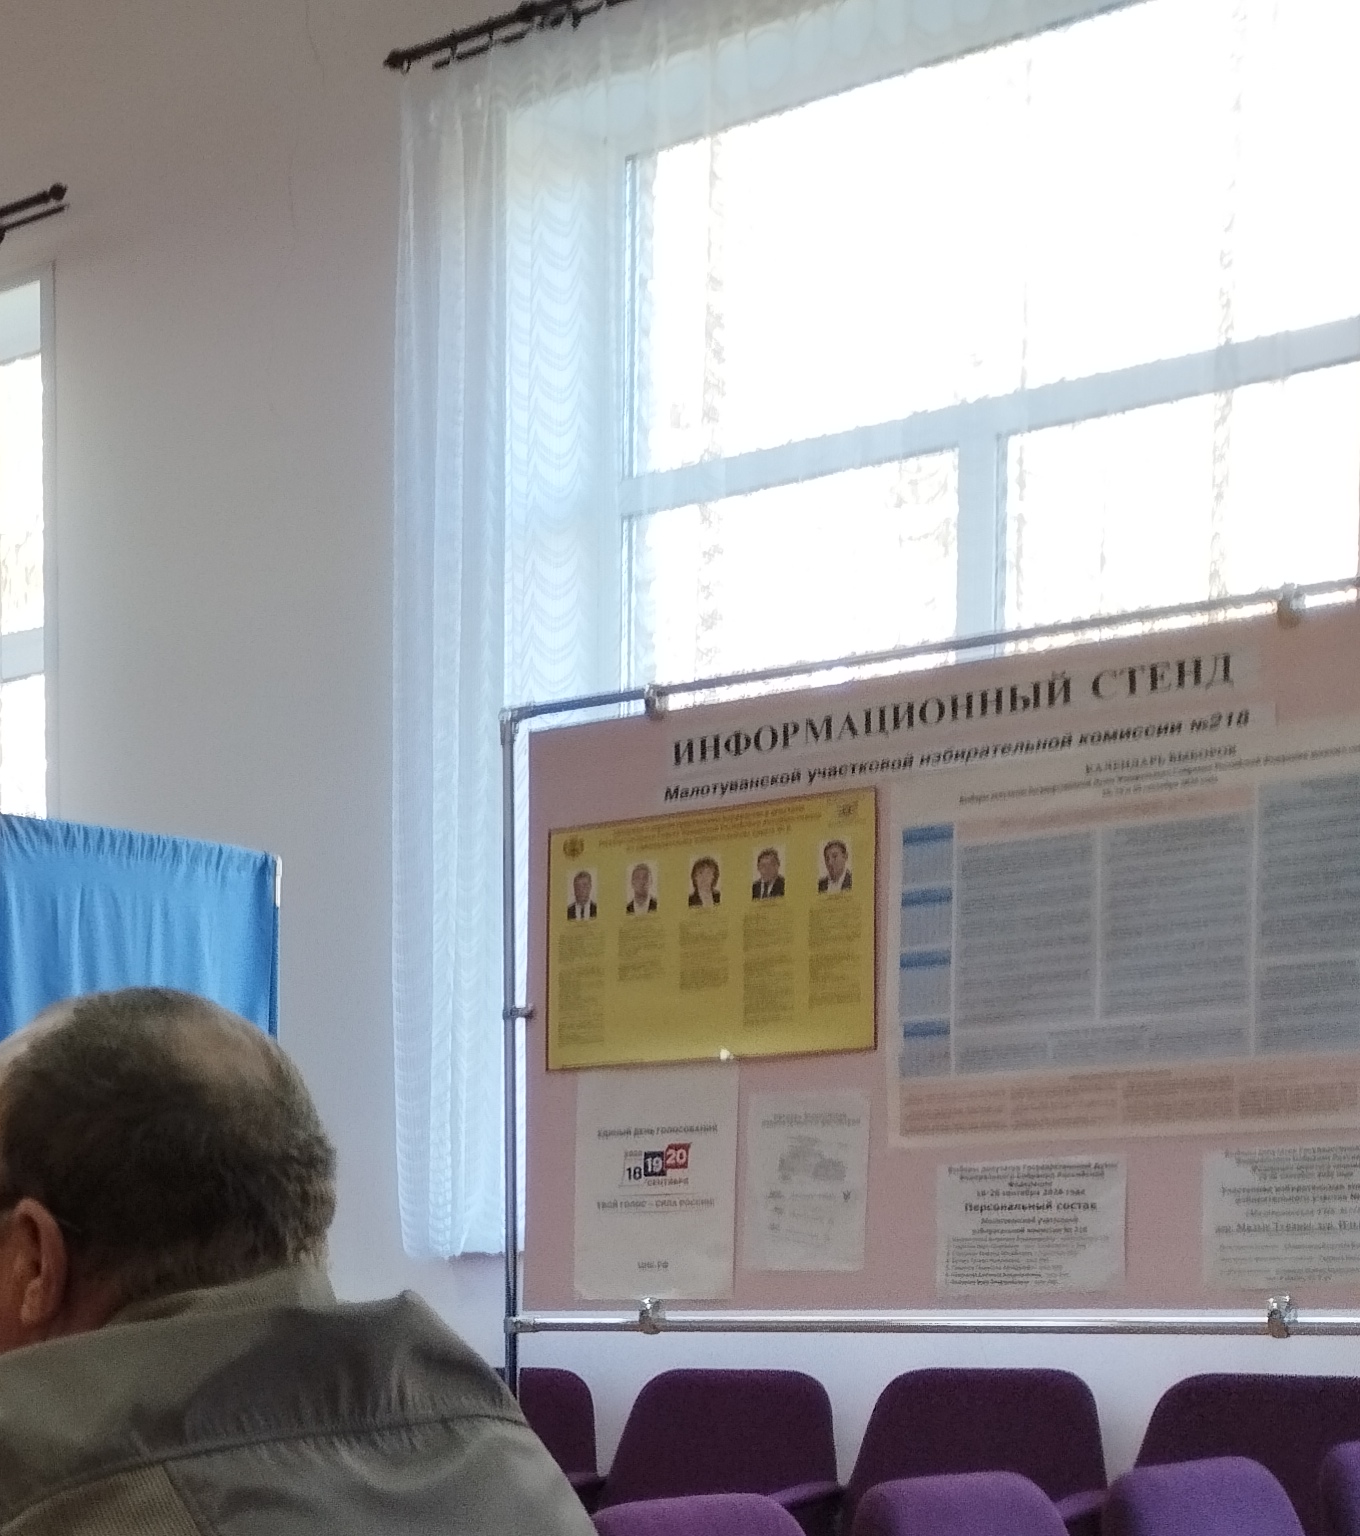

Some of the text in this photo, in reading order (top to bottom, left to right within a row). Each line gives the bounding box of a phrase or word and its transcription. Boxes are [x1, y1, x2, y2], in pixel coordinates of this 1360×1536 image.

[673, 652, 1233, 767] ИНФОРМАЦИОННЫЙ СТЕНД
[919, 732, 1073, 767] избирательной
[1079, 720, 1183, 745] комиссии
[626, 1148, 687, 1180] 18 19 20
